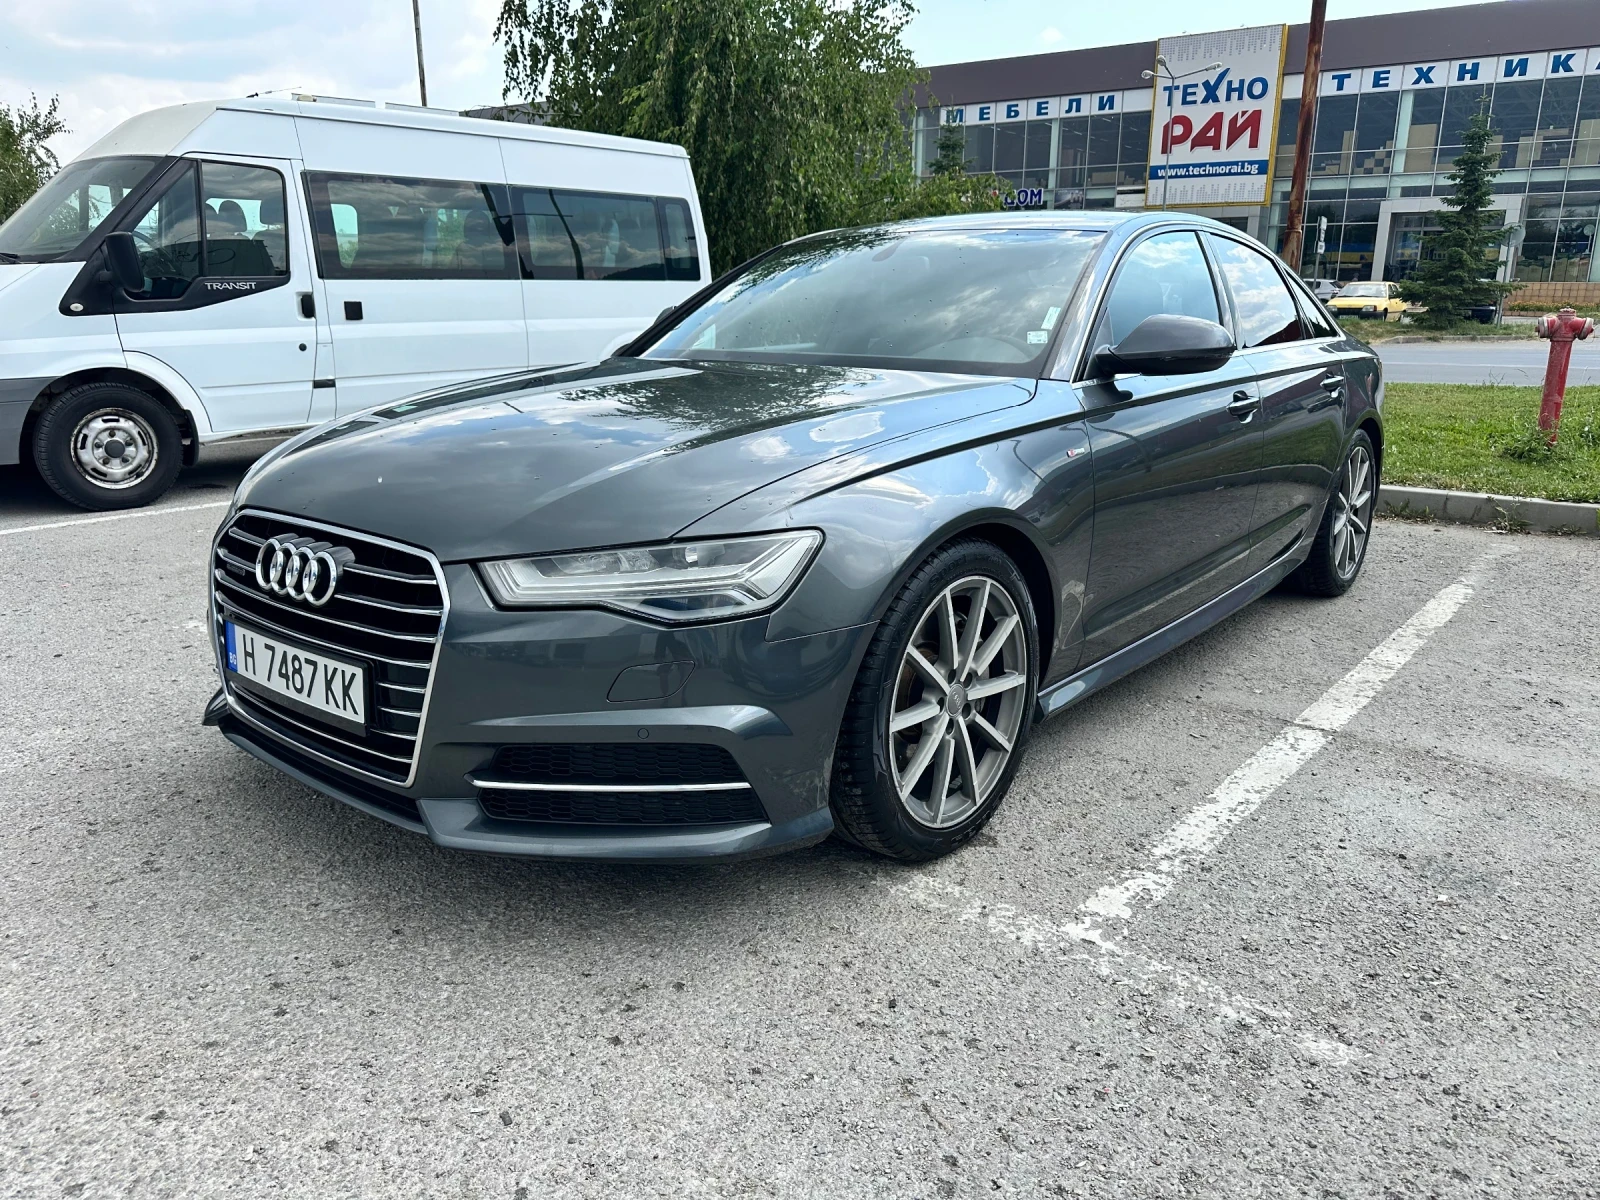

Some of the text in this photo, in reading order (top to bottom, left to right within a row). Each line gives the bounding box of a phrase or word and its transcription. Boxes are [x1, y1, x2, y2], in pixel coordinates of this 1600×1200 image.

[1163, 68, 1269, 107] ТЕХНО
[1332, 52, 1600, 91] ТЕХНИК
[946, 95, 1115, 124] МЕБЕЛИ
[1161, 109, 1262, 154] РАЙ
[1157, 162, 1259, 176] www.technorai.bg
[205, 281, 256, 290] TRANSIT
[229, 652, 237, 665] BG
[243, 634, 359, 715] H 7487 KK
